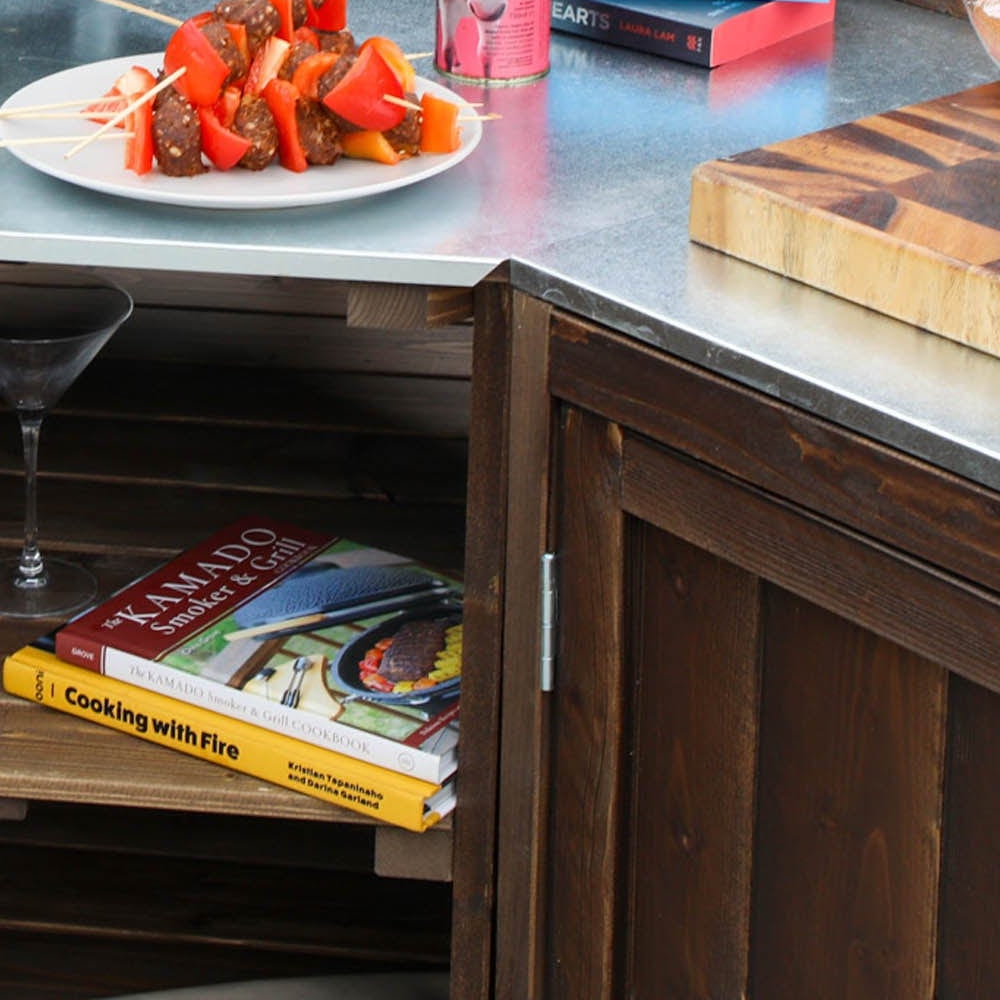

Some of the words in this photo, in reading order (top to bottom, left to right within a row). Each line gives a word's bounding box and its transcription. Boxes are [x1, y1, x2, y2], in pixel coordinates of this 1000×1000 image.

[551, 0, 611, 30] EARTS
[619, 20, 650, 37] LAURA
[653, 30, 676, 43] LAM
[116, 528, 277, 626] KAMADO
[150, 585, 236, 635] Smoker
[230, 573, 258, 586] &
[250, 537, 307, 571] Grill
[71, 647, 95, 661] GROVE
[64, 686, 148, 733] Cooking
[151, 716, 197, 745] with
[201, 731, 240, 760] Fire
[148, 671, 204, 697] KAMADO
[207, 691, 247, 713] Smoker
[262, 709, 289, 728] Grill
[291, 720, 371, 754] COOKBOOK
[288, 761, 325, 780] Kristian
[326, 773, 384, 800] Tapaninaho
[288, 772, 306, 785] and
[307, 779, 339, 798] Darina
[340, 791, 380, 810] Garland
